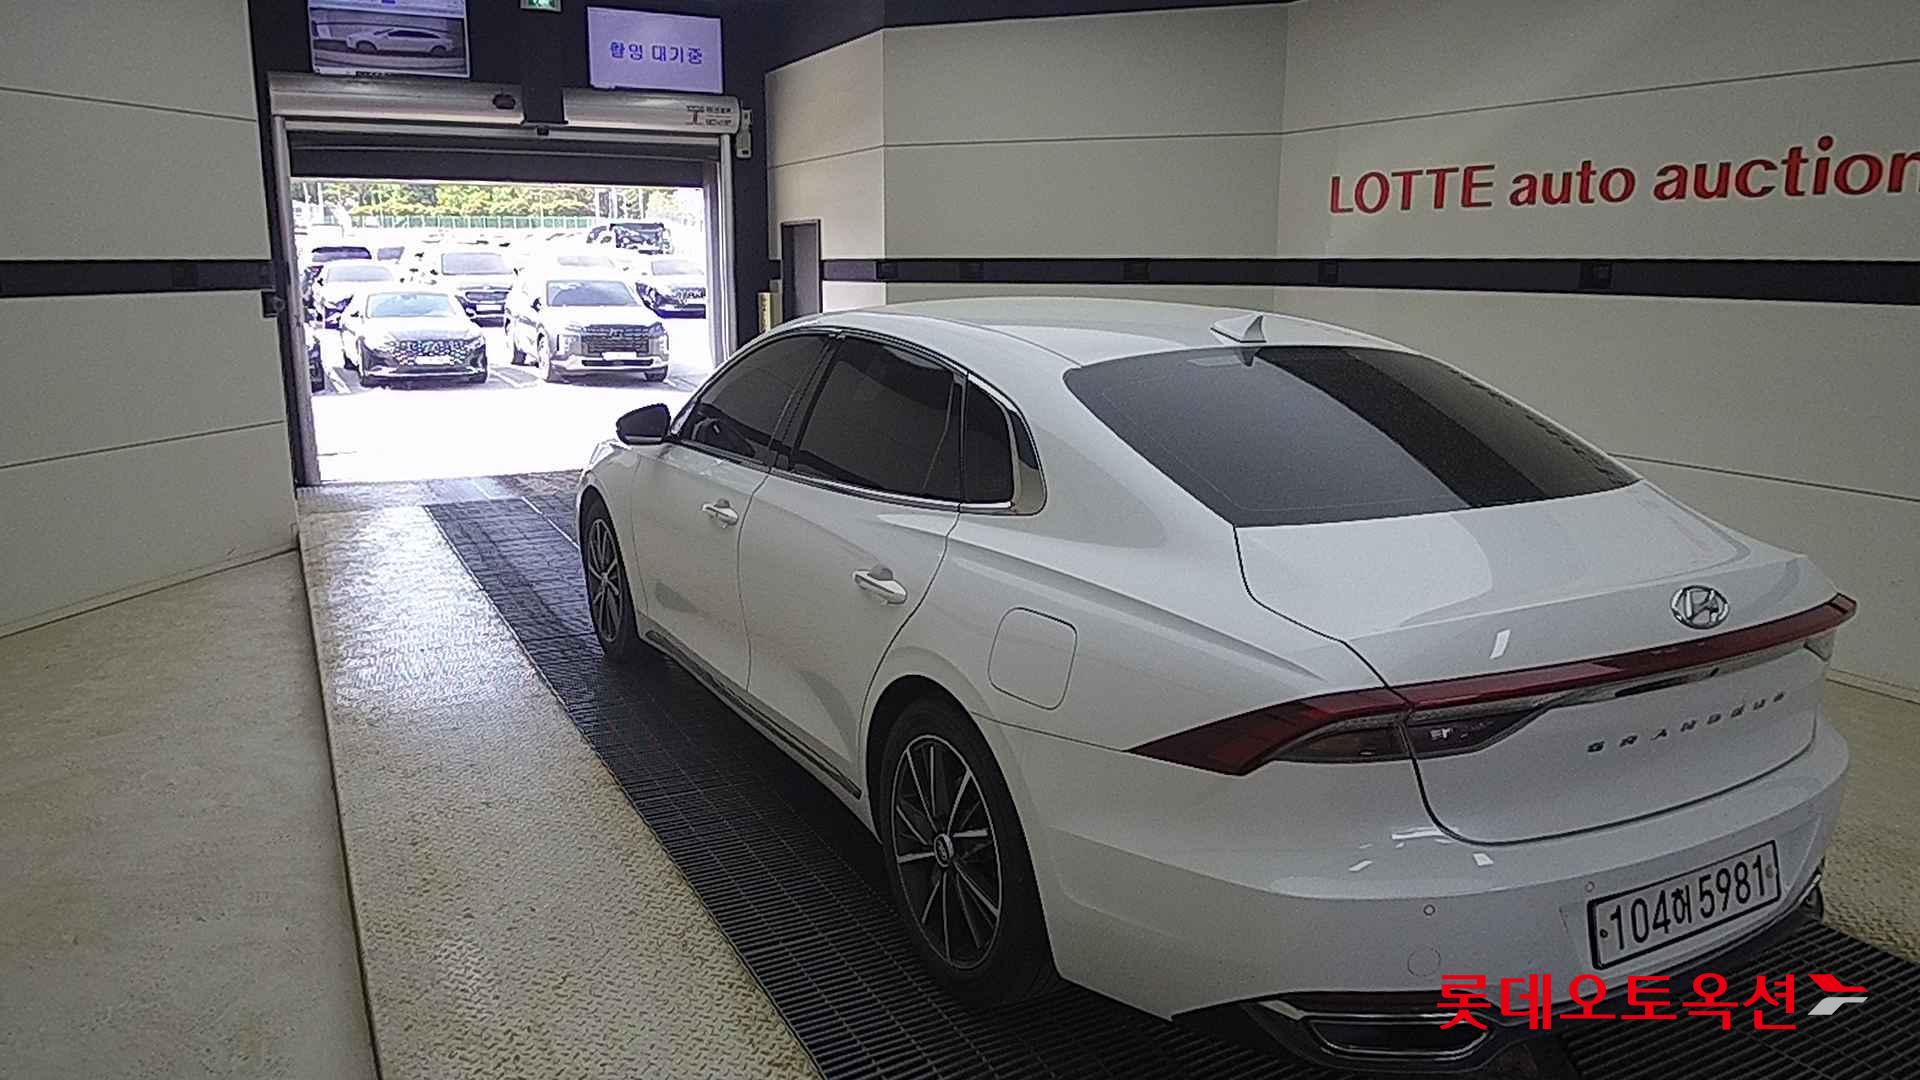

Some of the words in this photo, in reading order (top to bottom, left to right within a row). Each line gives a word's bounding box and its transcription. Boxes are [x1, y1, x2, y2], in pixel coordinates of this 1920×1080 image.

[651, 44, 703, 65] 대기중
[1329, 163, 1496, 214] LOTTE
[1508, 159, 1637, 208] auto
[1652, 134, 1920, 201] auction
